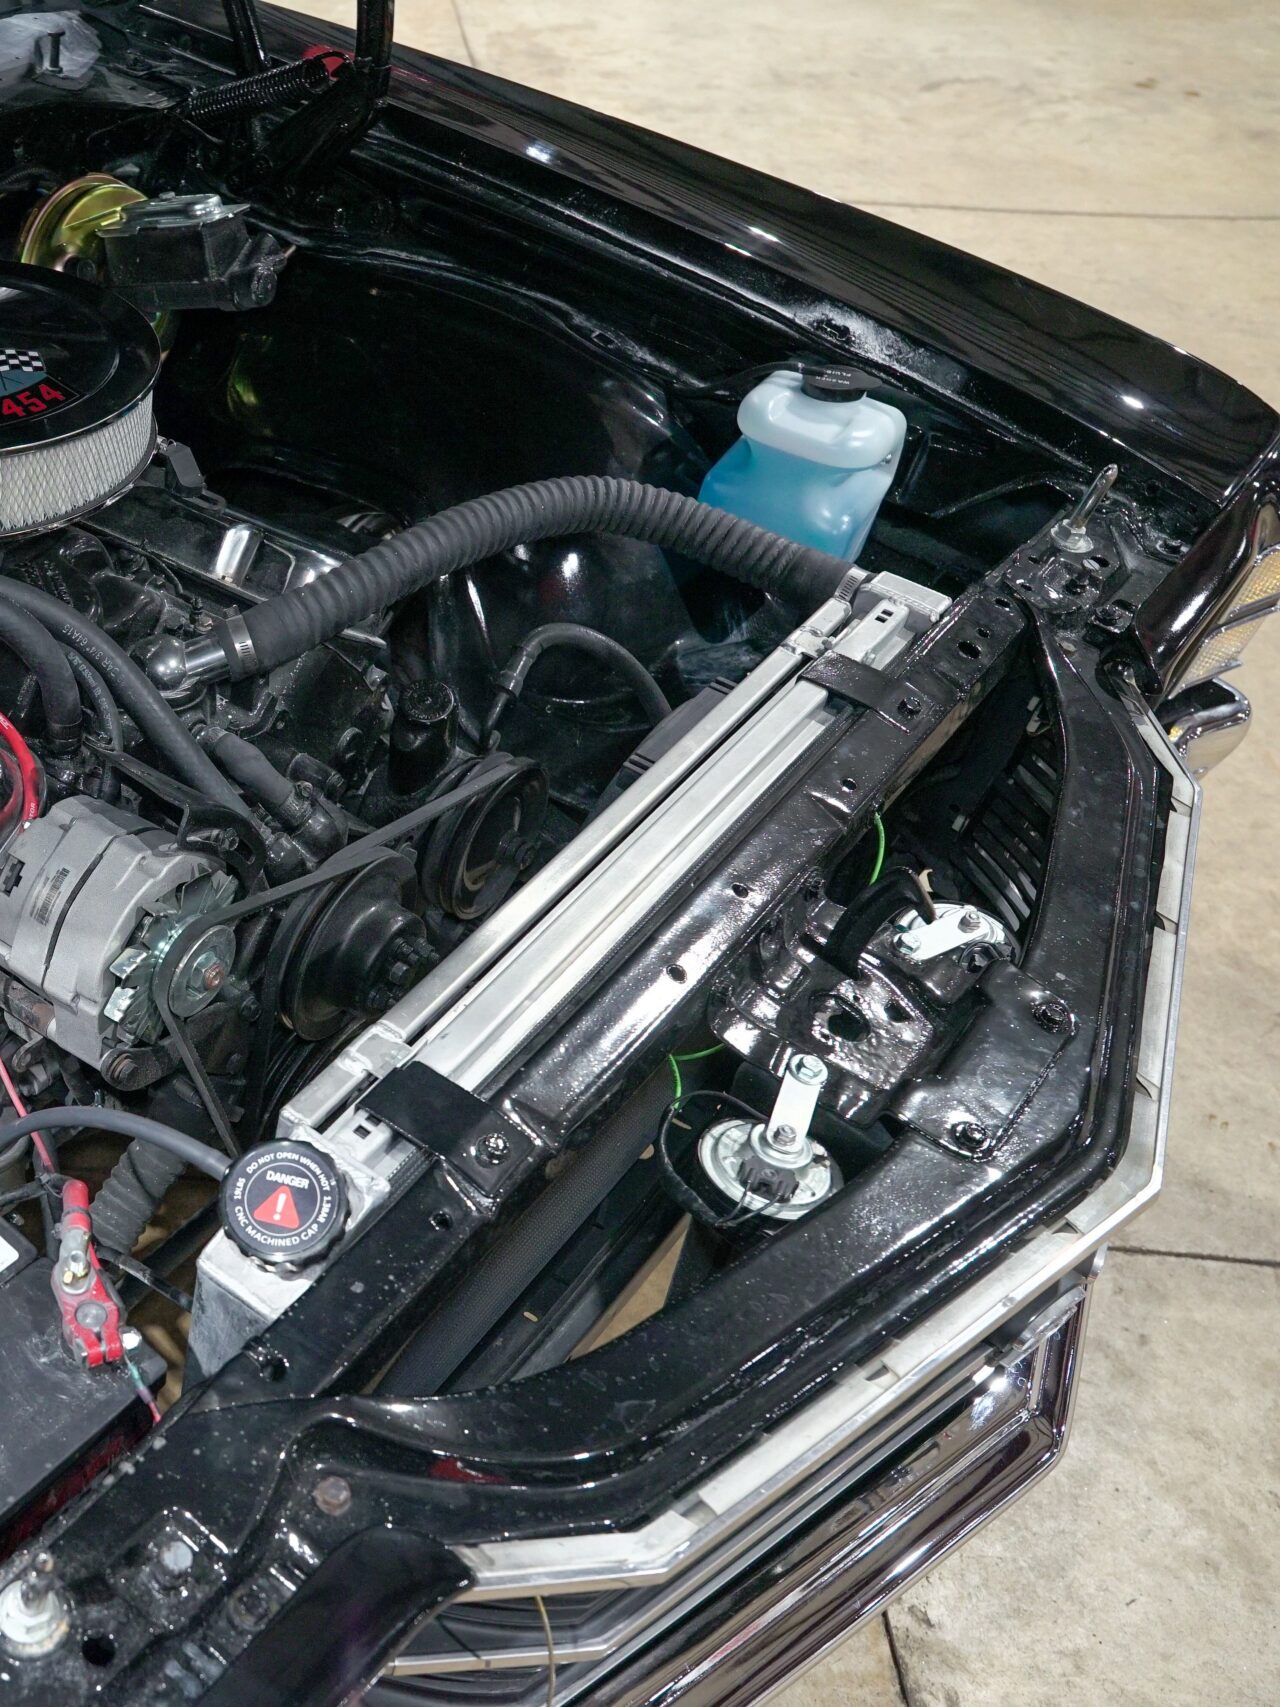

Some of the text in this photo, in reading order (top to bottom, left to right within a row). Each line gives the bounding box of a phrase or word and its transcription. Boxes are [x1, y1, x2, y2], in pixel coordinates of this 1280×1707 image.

[1, 383, 66, 417] 454
[233, 1177, 246, 1199] 19LBS
[246, 1152, 330, 1191] DO NOT OPEN WHEN HOT
[266, 1170, 310, 1189] DANGER
[234, 1206, 320, 1246] CNC MACHINED CAP
